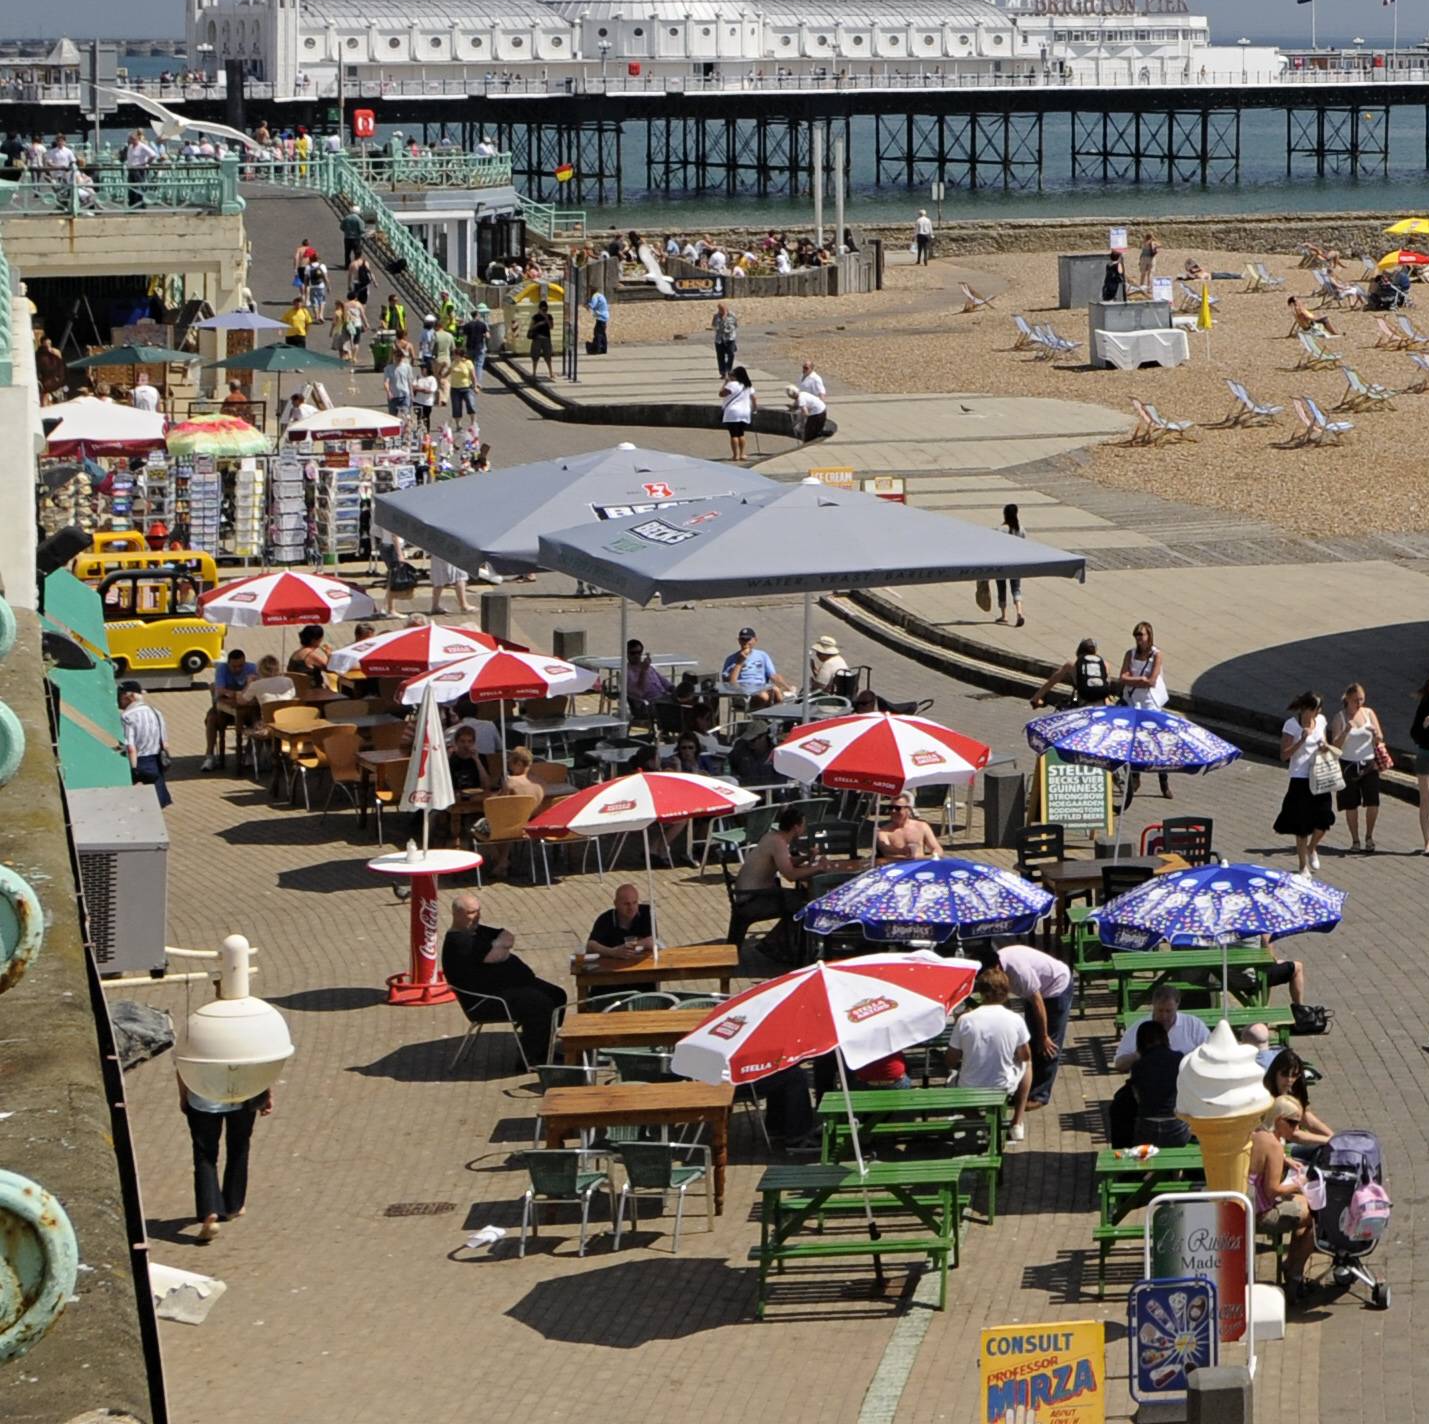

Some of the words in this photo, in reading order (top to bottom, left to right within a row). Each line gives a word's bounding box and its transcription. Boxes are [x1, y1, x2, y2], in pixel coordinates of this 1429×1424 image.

[1048, 764, 1104, 776] STELLA
[1048, 783, 1105, 793] GUINNESS
[1048, 792, 1105, 800] STRONGBOW
[740, 1062, 773, 1074] STELLA
[1181, 1256, 1222, 1270] Made
[985, 1332, 1075, 1356] CONSULT
[986, 1356, 1059, 1384] PROFESSOR
[987, 1358, 1098, 1423] MIRZA
